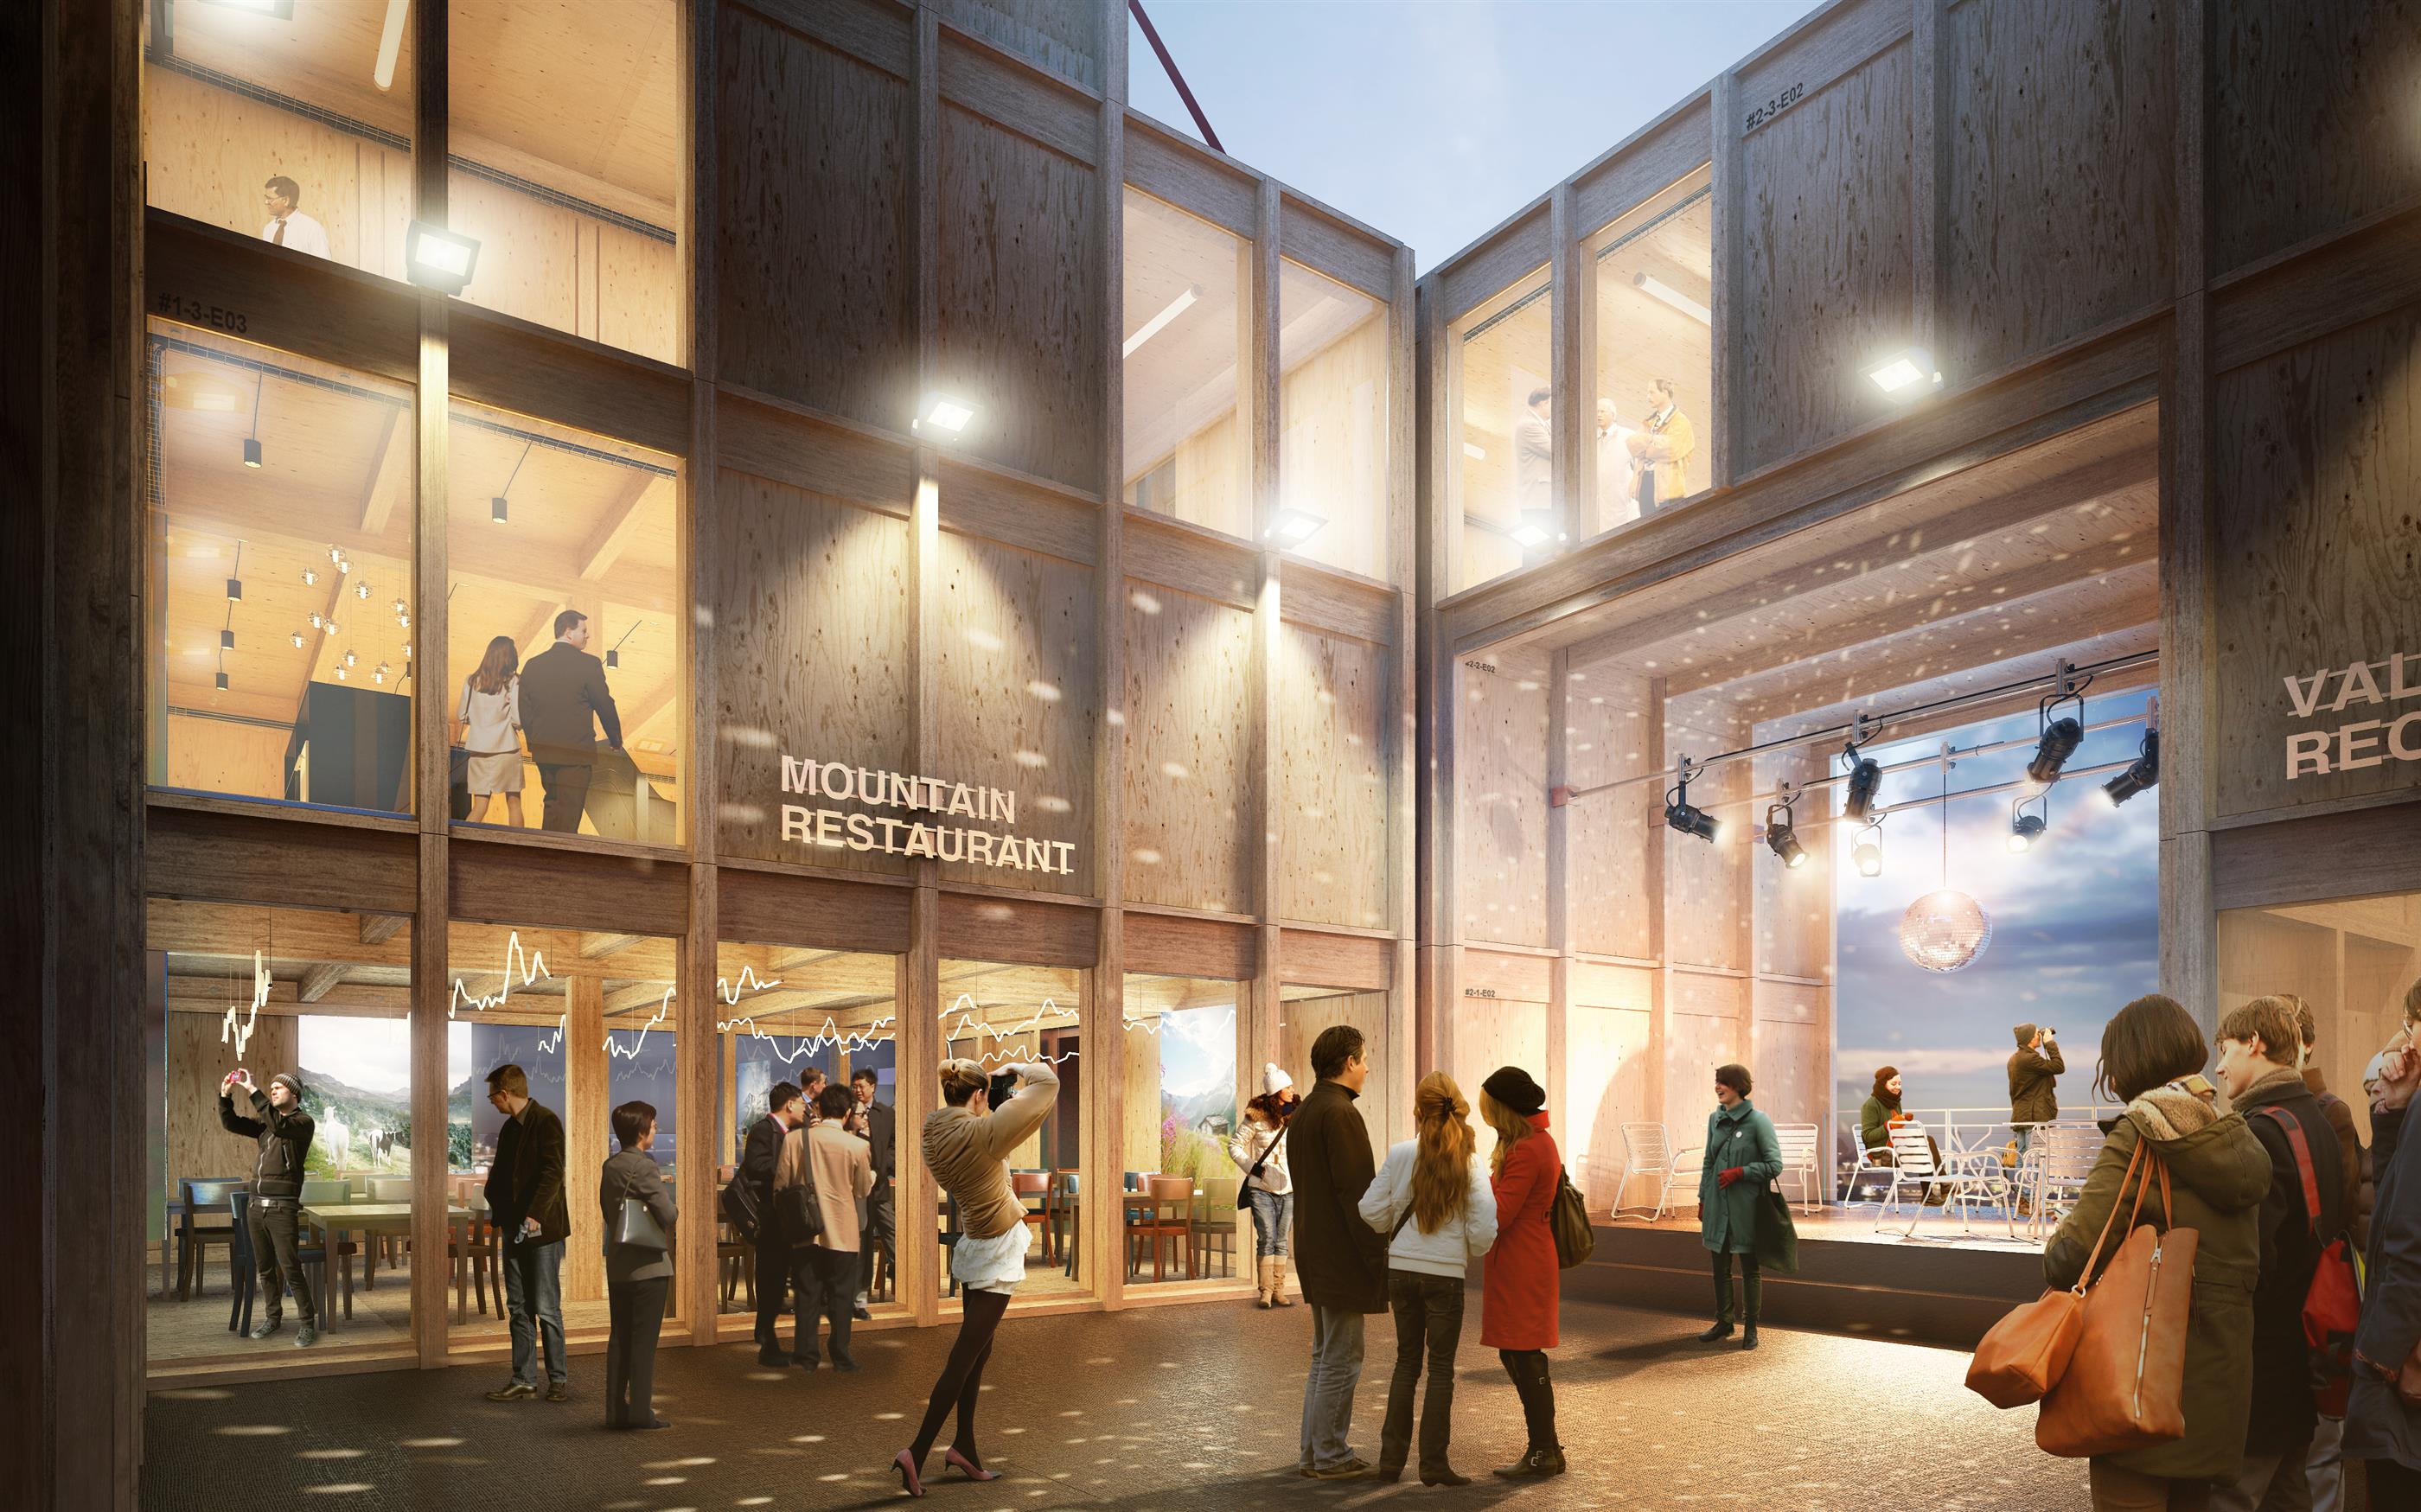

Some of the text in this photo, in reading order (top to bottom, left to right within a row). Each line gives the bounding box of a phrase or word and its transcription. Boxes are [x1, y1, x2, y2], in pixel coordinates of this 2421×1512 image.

[1746, 82, 1804, 131] #2-3-E02
[158, 292, 248, 334] #1-3-E03
[781, 755, 1015, 824] MOUNTAIN
[782, 804, 1076, 876] RESTAURANT
[1465, 988, 1496, 998] #2-1-E02
